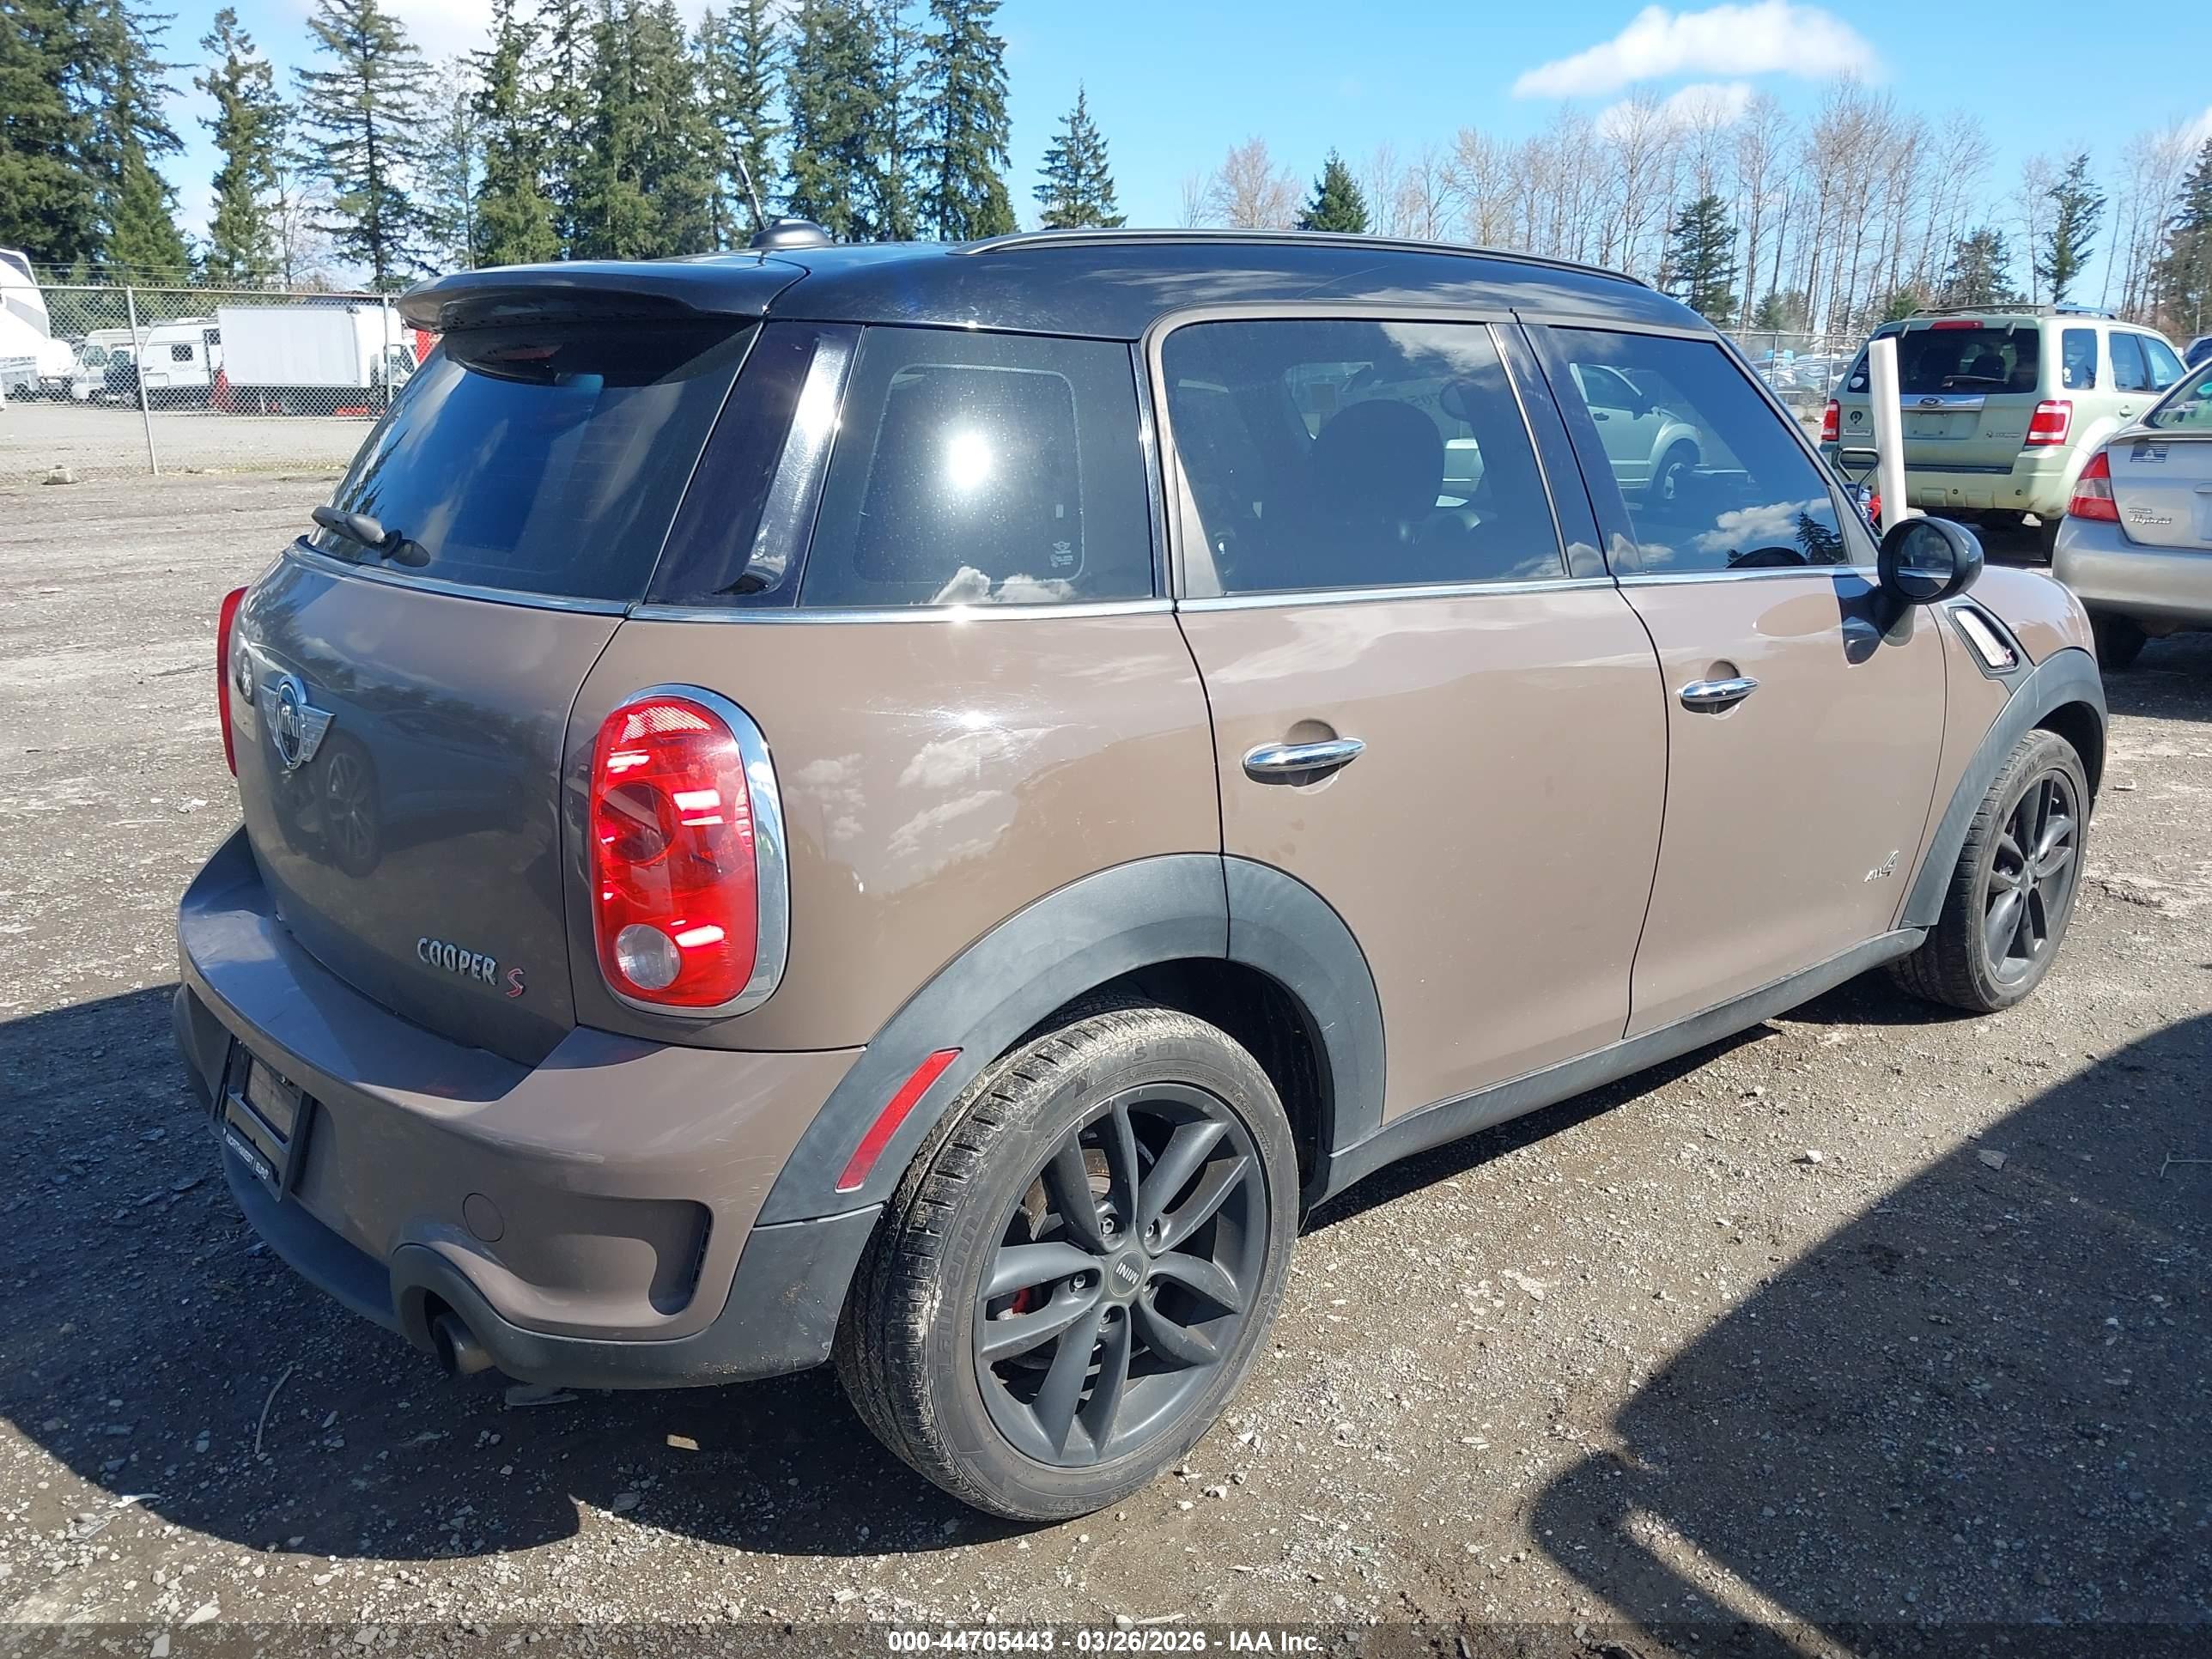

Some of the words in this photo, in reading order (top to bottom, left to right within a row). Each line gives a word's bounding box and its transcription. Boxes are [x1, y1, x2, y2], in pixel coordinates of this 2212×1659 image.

[417, 937, 496, 985] COOPER
[506, 968, 525, 998] S
[1115, 1261, 1140, 1285] MINI
